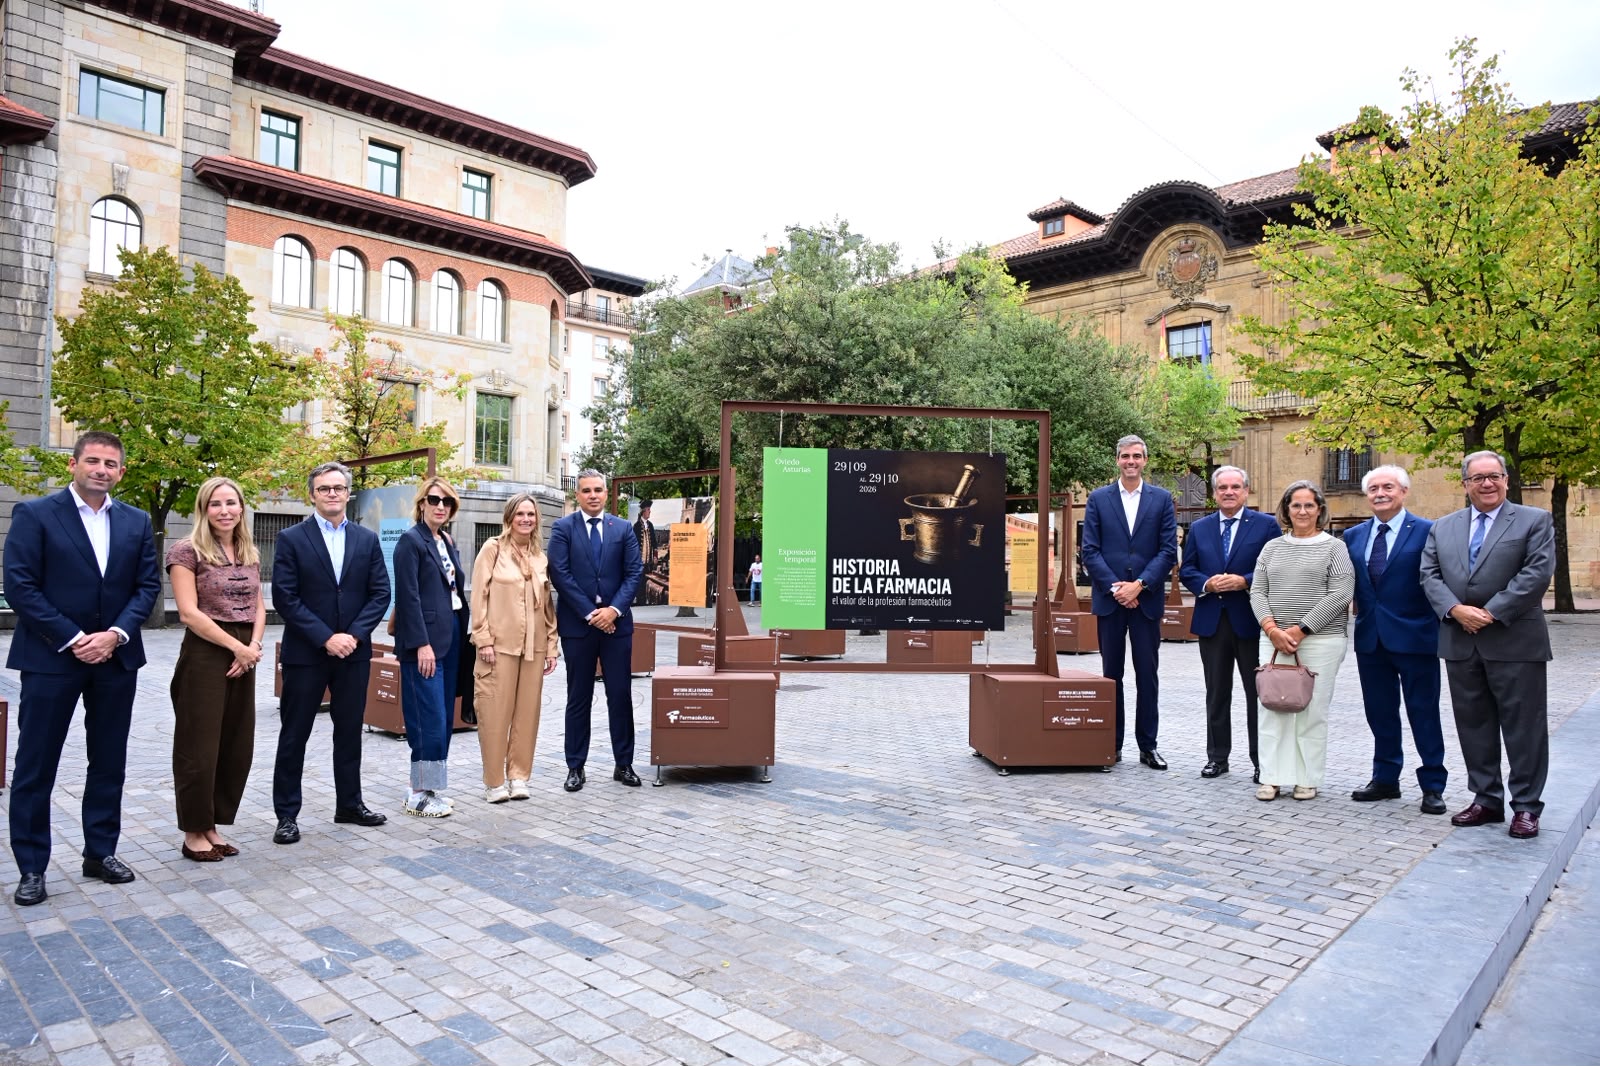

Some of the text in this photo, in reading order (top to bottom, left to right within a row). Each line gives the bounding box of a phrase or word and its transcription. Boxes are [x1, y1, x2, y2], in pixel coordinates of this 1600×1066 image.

[859, 485, 877, 493] 2026
[778, 548, 816, 557] Exposición
[784, 556, 816, 564] temporal
[832, 558, 901, 576] HISTORIA
[832, 577, 851, 594] DE
[854, 577, 873, 594] LA
[876, 577, 952, 595] FARMACIA
[832, 596, 952, 607] el valor de la profesión farmacéutica
